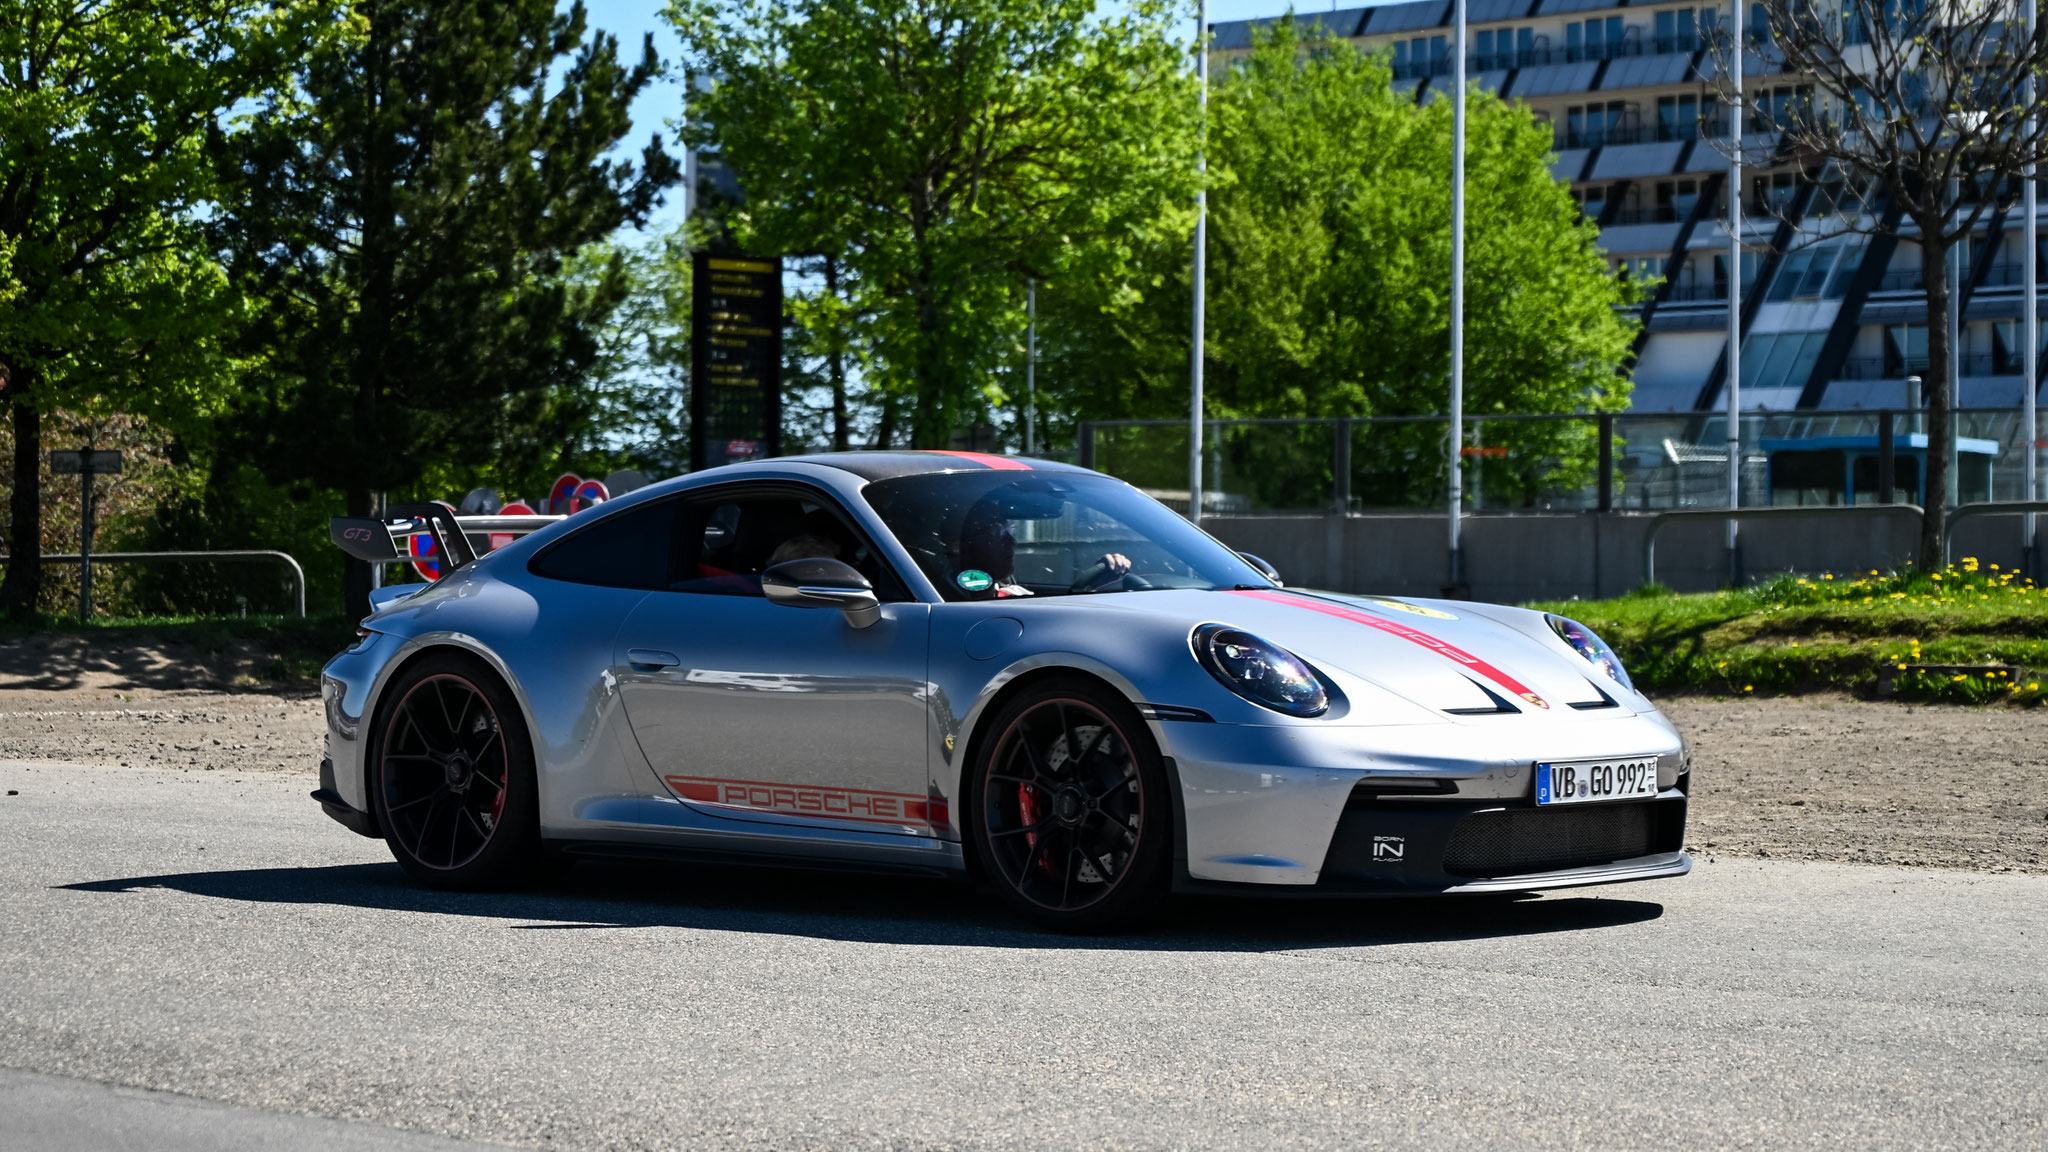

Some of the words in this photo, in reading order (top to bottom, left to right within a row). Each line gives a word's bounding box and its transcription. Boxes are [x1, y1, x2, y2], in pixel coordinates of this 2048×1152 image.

[344, 527, 372, 542] GT3
[969, 572, 978, 581] 4
[1552, 767, 1576, 798] VB
[1591, 765, 1613, 795] GO
[1617, 763, 1646, 794] 992
[1541, 788, 1548, 797] D
[725, 785, 898, 817] PORSCHE
[1373, 842, 1404, 857] IN
